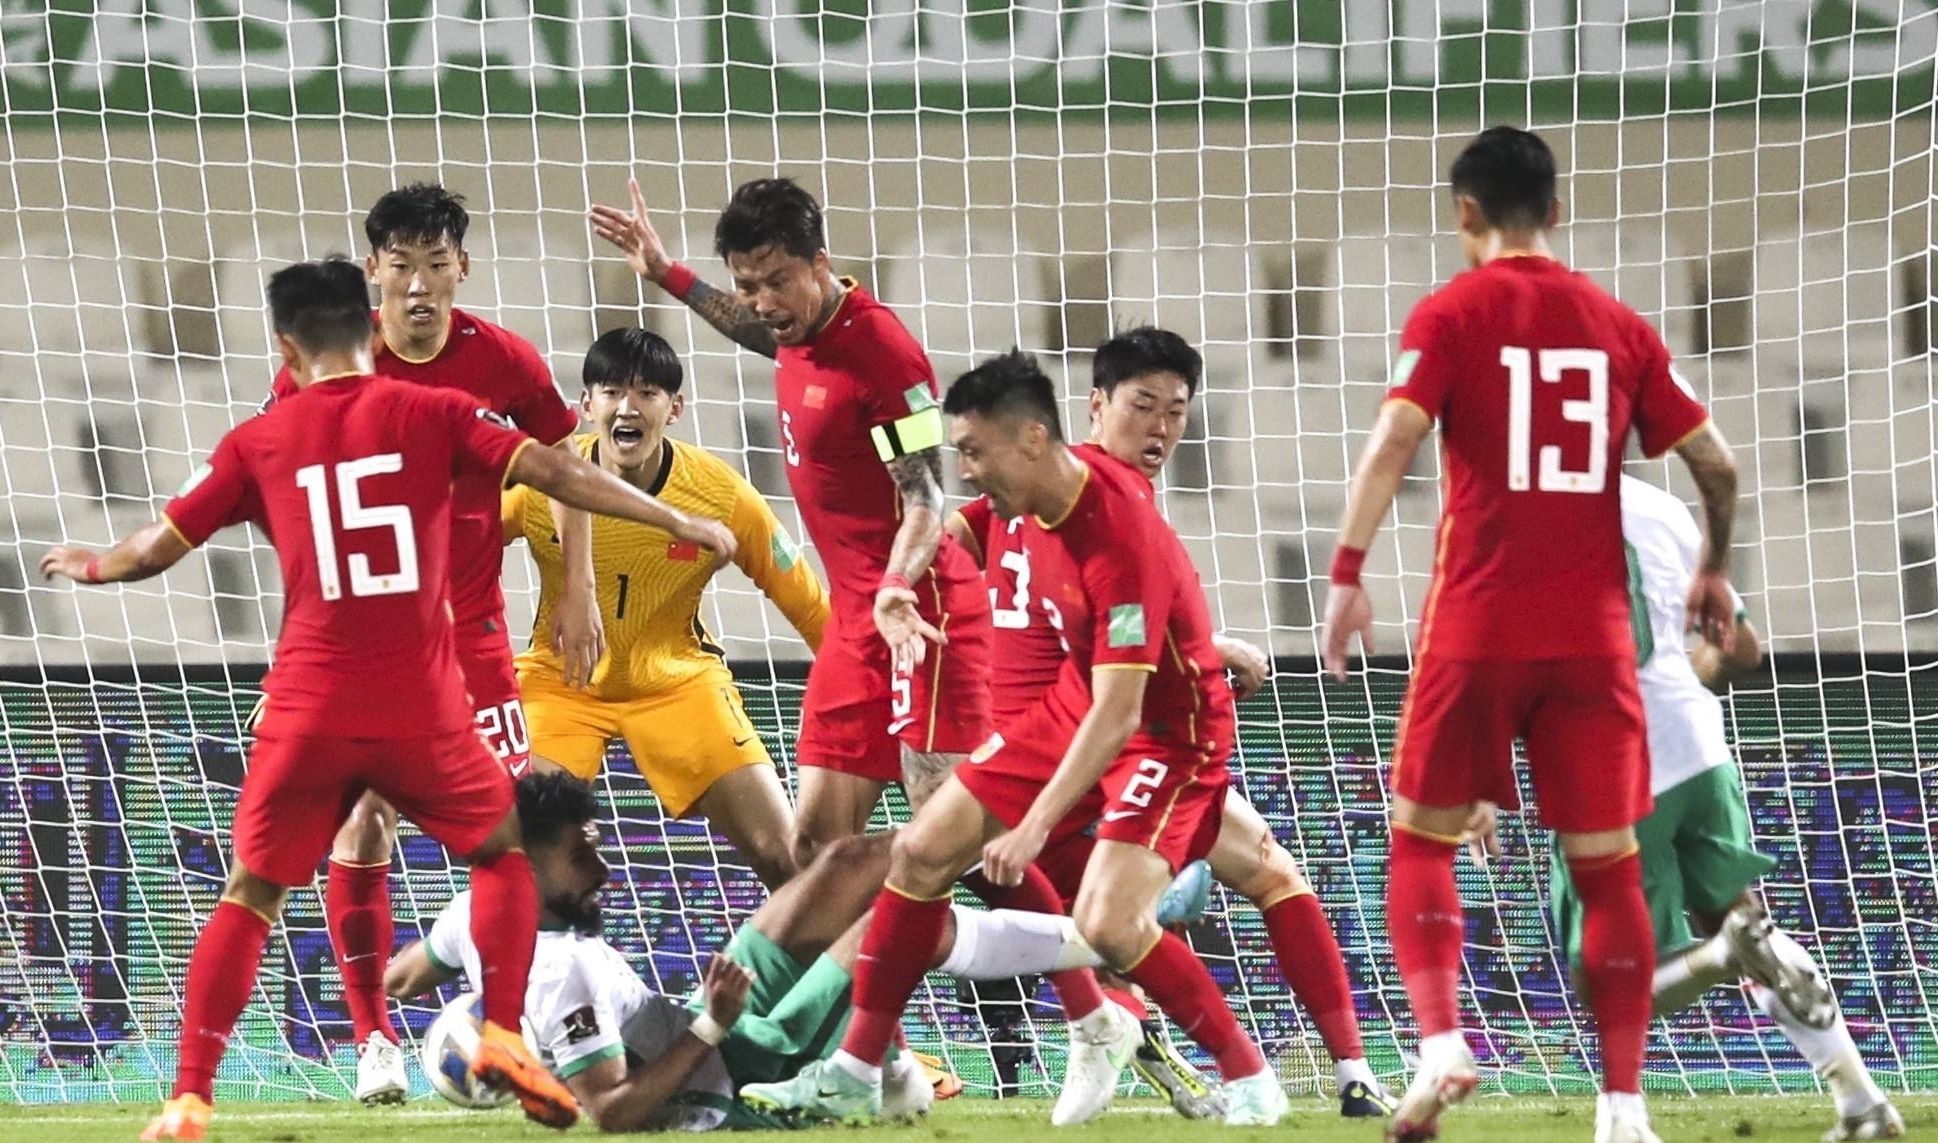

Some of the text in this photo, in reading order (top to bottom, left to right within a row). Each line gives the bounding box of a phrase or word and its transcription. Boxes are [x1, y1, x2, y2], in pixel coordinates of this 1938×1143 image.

[1500, 346, 1609, 493] 13
[296, 453, 420, 600] 15
[616, 574, 629, 619] 1
[891, 660, 911, 718] 5
[475, 699, 530, 759] 20
[1120, 758, 1169, 807] 2
